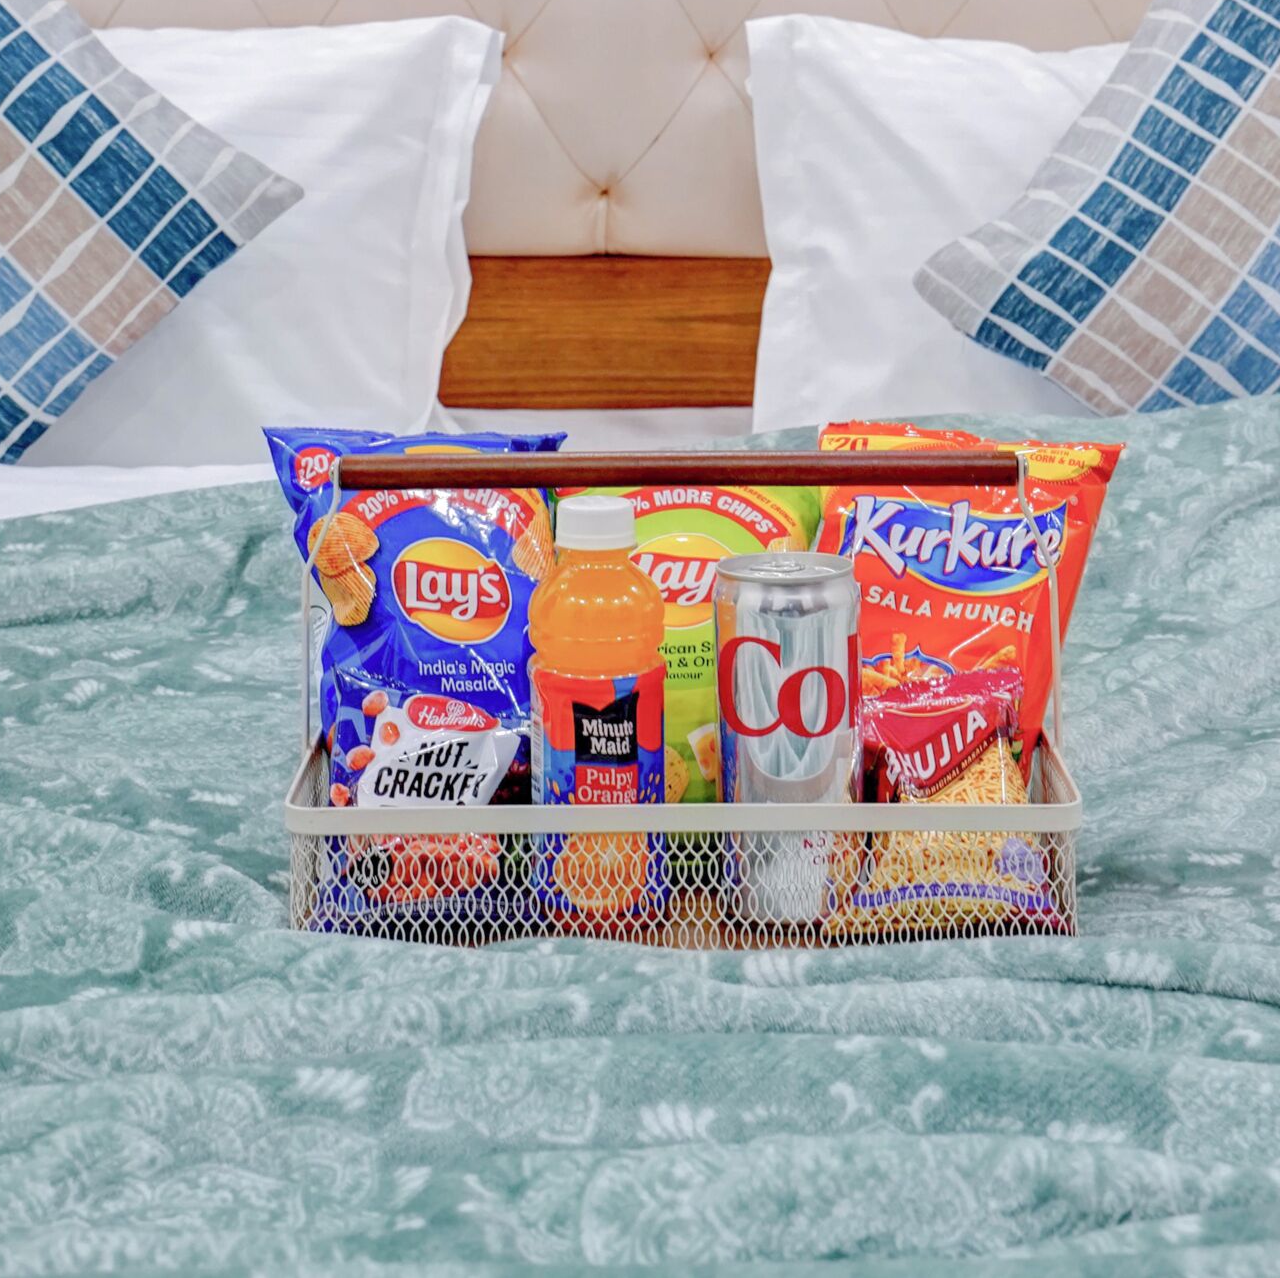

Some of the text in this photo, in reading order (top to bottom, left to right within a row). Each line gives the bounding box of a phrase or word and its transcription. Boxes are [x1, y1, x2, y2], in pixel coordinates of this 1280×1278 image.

[1029, 453, 1056, 464] CORN
[652, 488, 713, 508] MORE
[852, 495, 1063, 579] Kurkure
[404, 561, 503, 621] Lay's
[864, 585, 1035, 635] SALA MUNCH
[418, 658, 516, 678] India's Magic
[677, 656, 689, 668] &
[693, 655, 714, 668] On
[440, 675, 500, 693] Masala
[665, 670, 704, 680] lavour
[581, 718, 634, 738] Minute
[415, 741, 469, 768] NUT
[590, 736, 631, 756] Maid
[884, 709, 988, 787] BHUJIA
[586, 767, 634, 790] Pulpy
[577, 785, 638, 804] Orange
